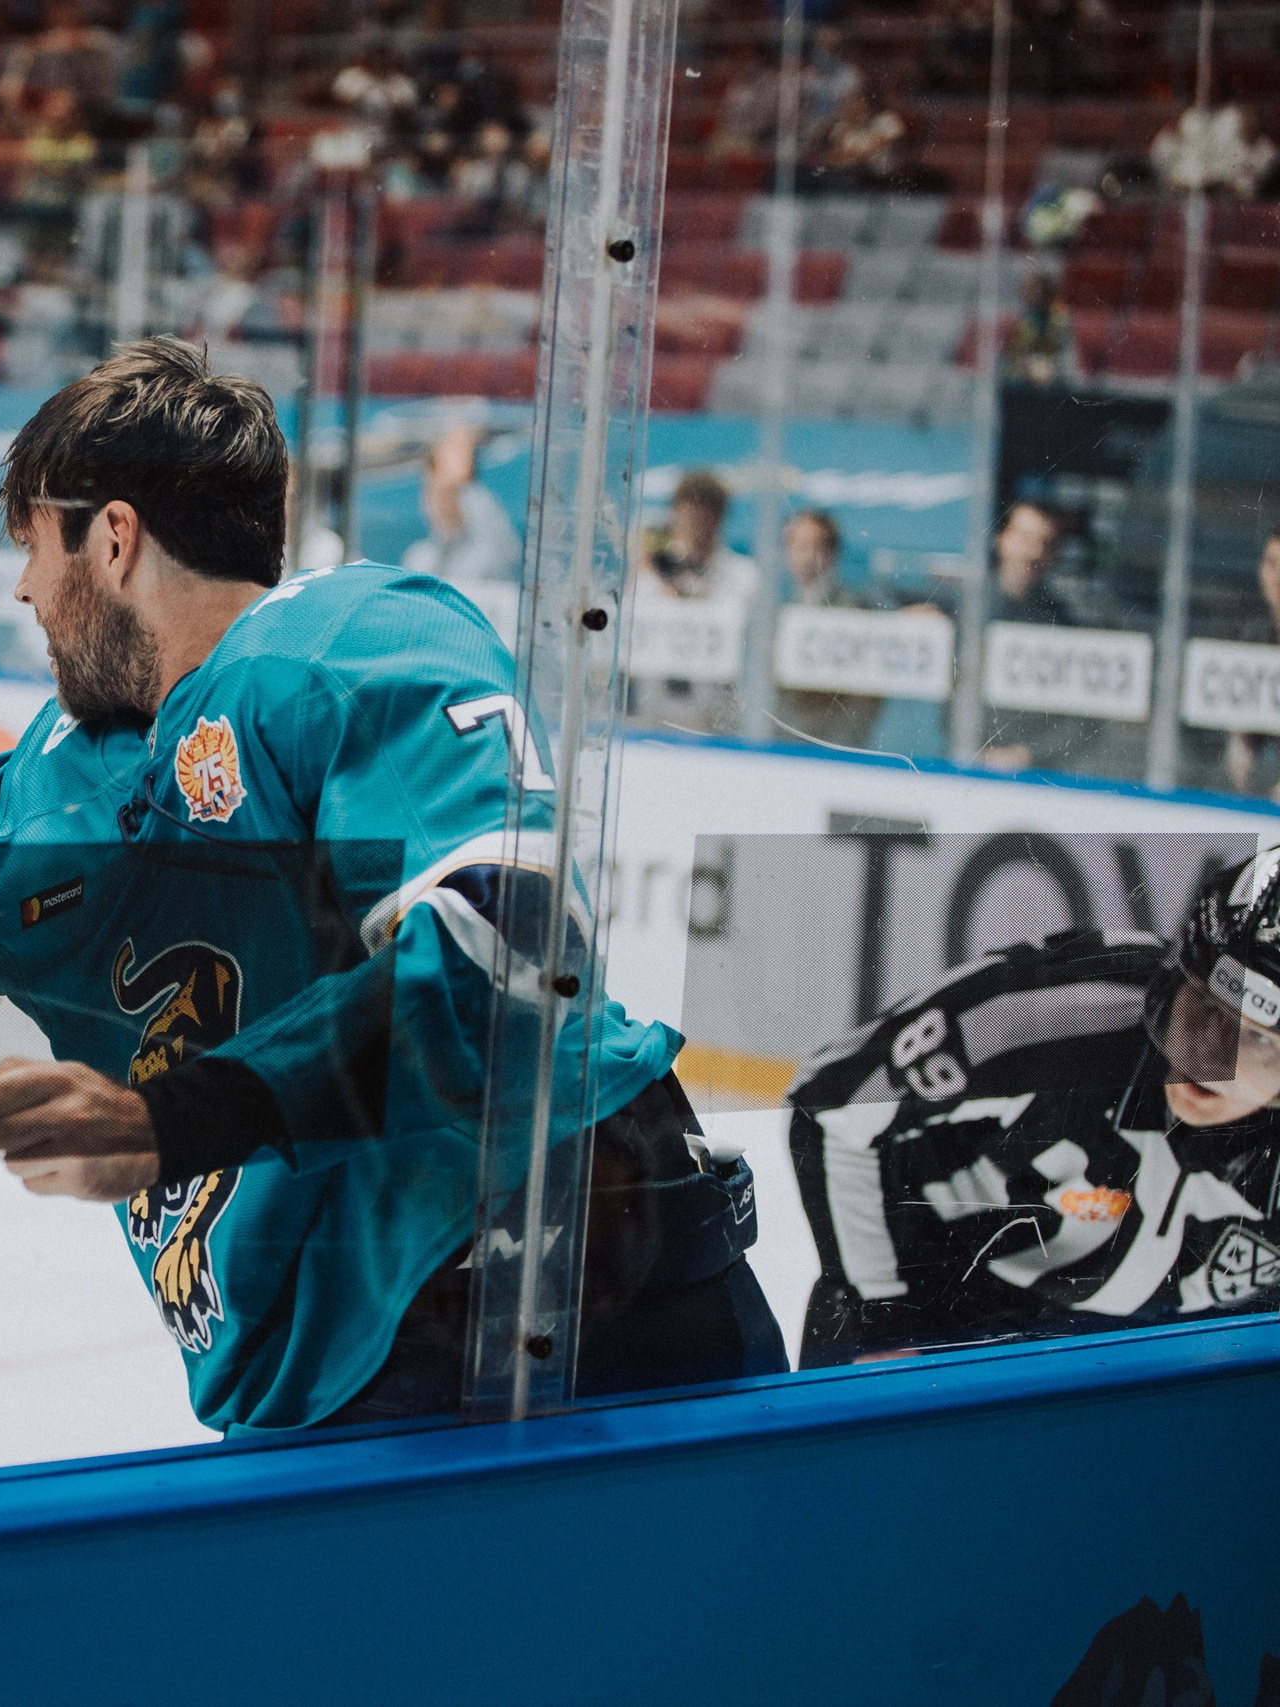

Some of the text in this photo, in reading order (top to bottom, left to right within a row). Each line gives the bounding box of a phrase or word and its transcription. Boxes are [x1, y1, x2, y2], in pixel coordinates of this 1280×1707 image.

[193, 750, 232, 804] 75
[43, 883, 82, 909] mastercard
[890, 1007, 968, 1102] 89
